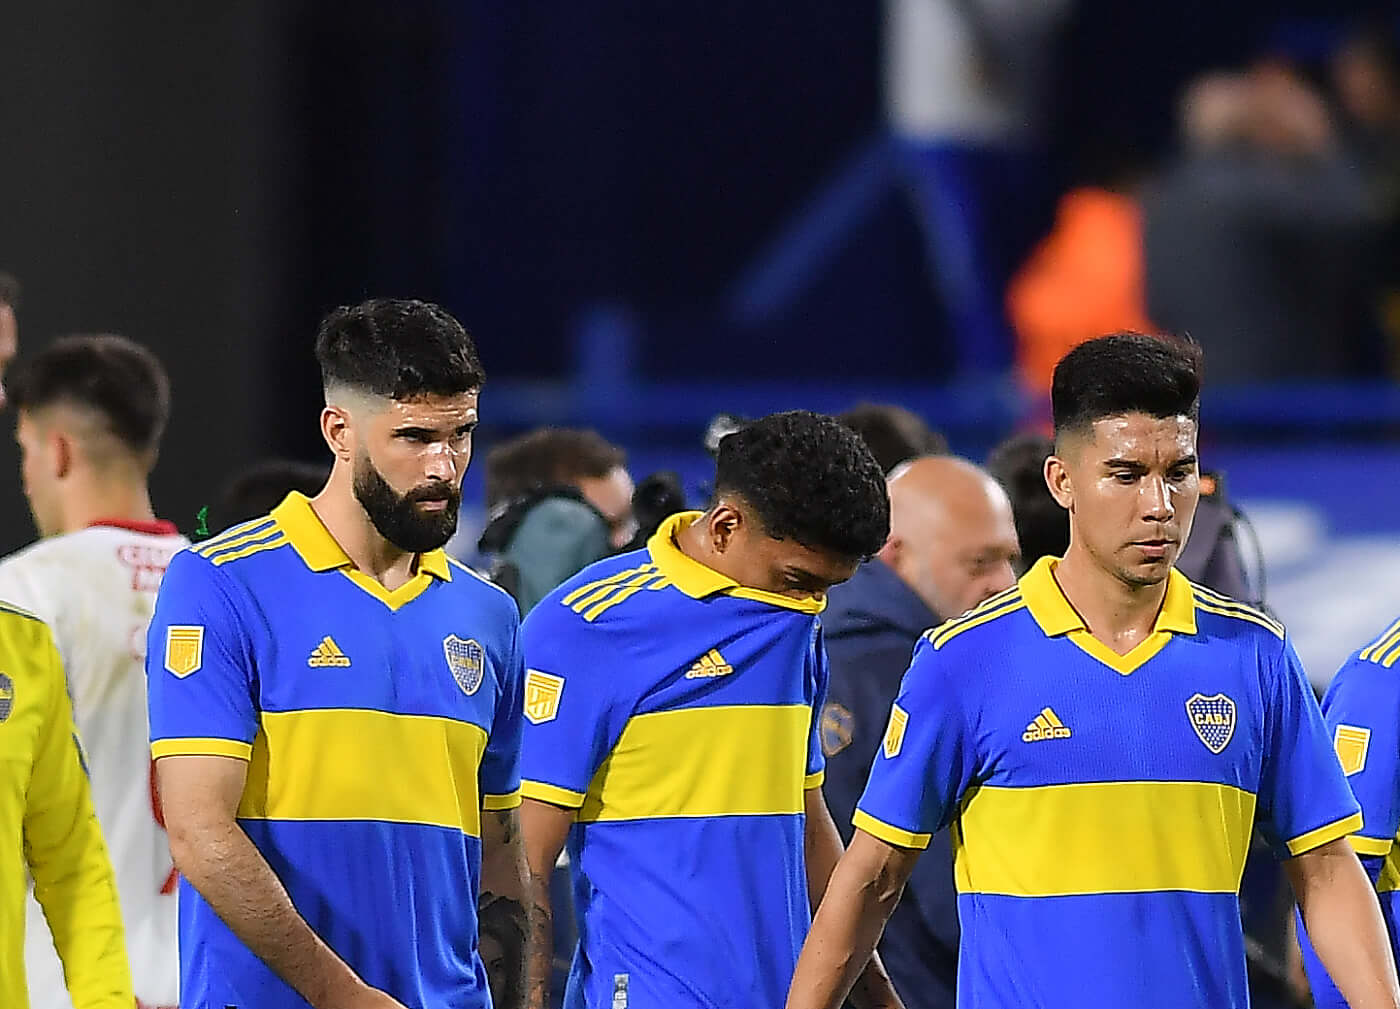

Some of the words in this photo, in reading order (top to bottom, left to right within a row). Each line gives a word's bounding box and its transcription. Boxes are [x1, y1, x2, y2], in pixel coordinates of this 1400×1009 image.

[685, 664, 734, 680] adidas
[1194, 713, 1231, 726] CABJ
[1022, 727, 1072, 743] adidas
